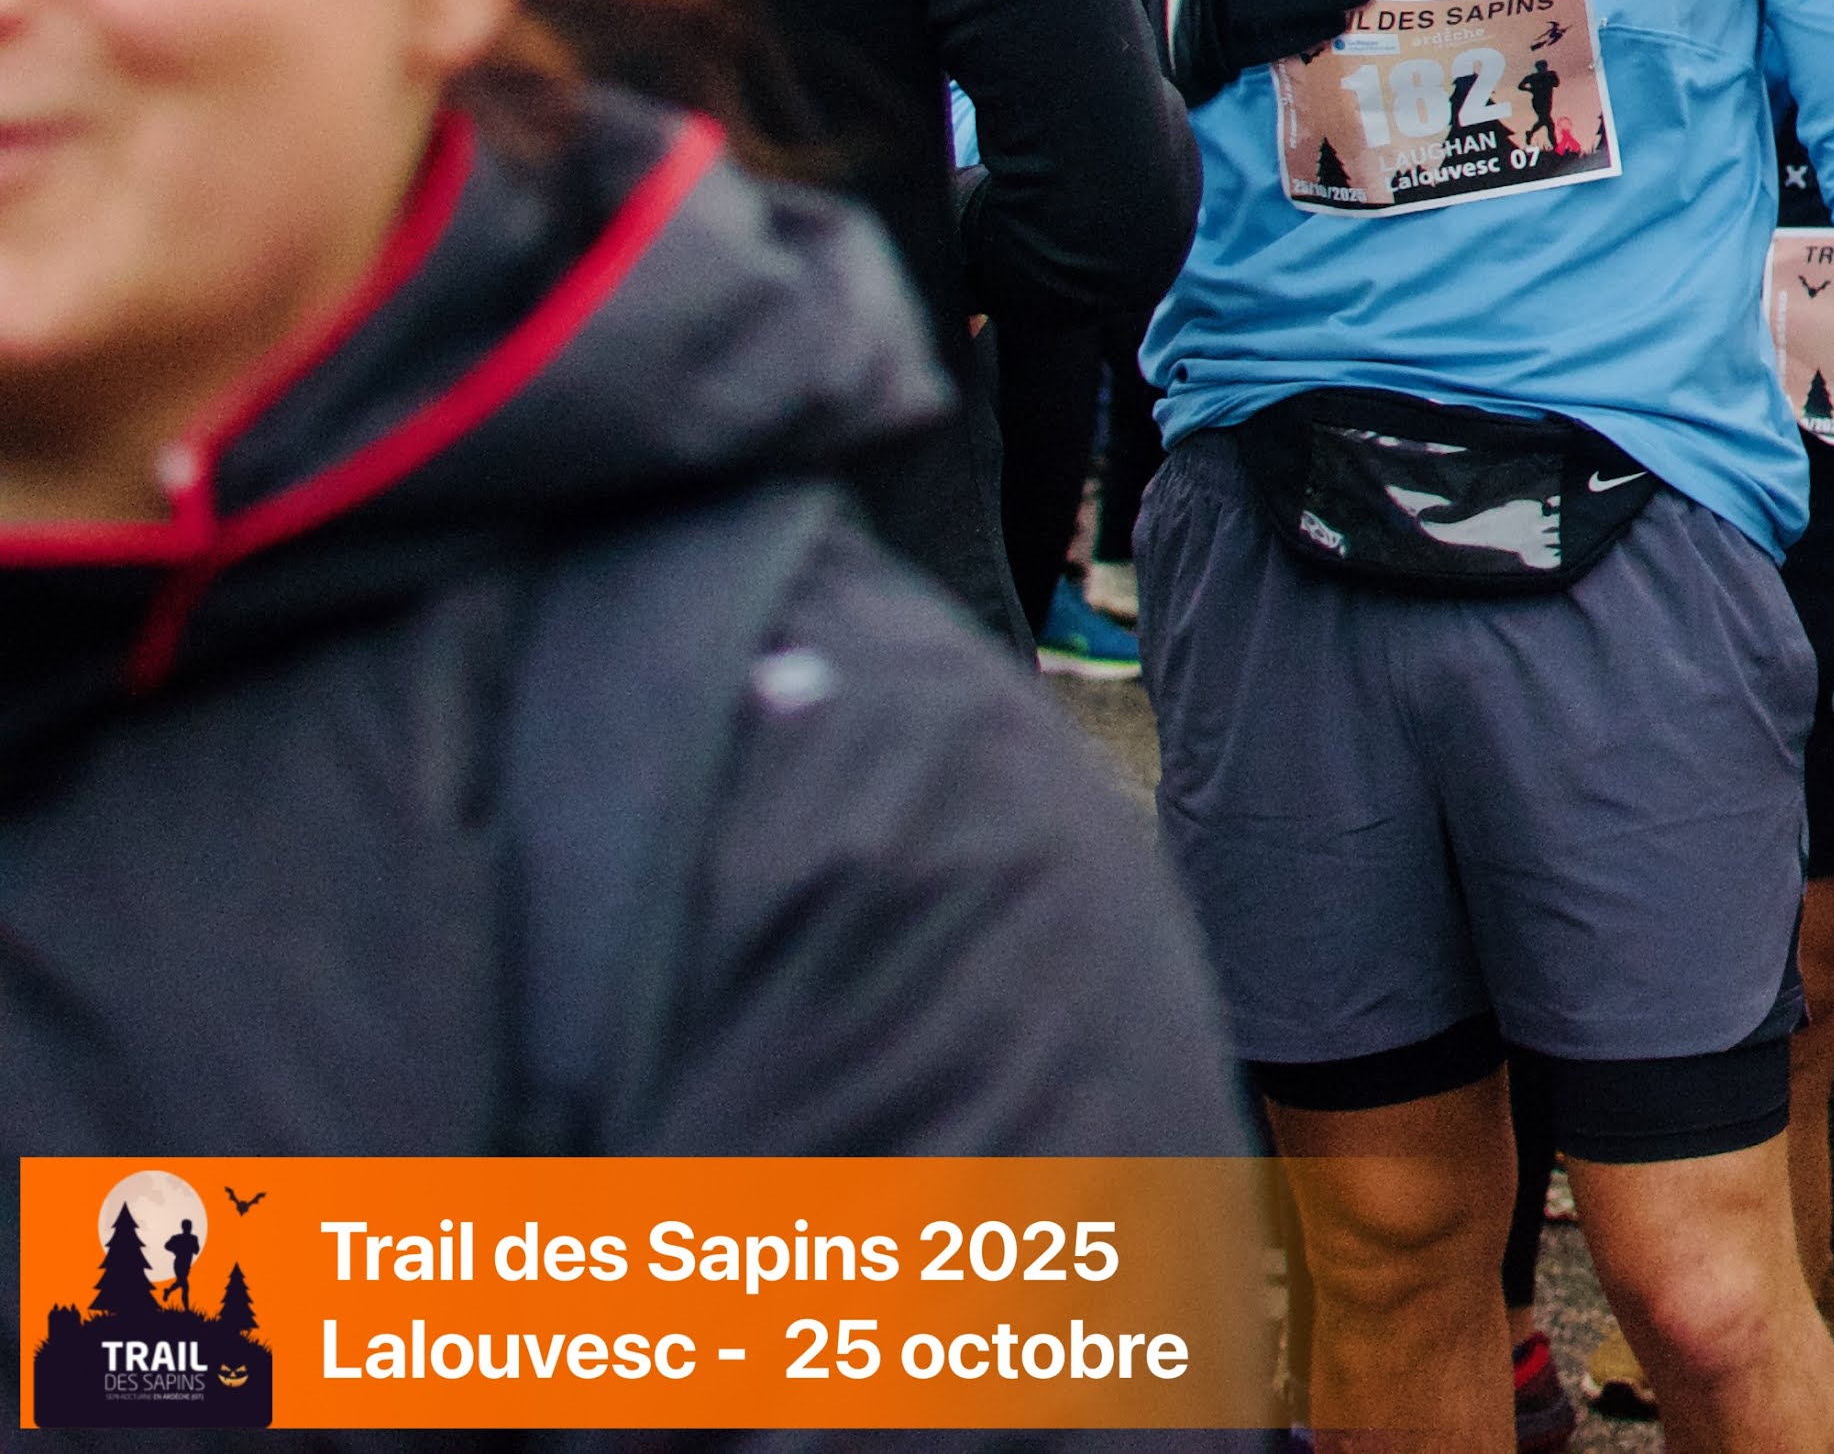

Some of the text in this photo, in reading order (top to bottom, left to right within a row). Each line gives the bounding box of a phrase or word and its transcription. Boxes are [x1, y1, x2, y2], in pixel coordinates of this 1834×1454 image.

[1378, 10, 1434, 31] DES
[1341, 48, 1512, 147] 182
[1386, 147, 1542, 192] Lalouvesc 07
